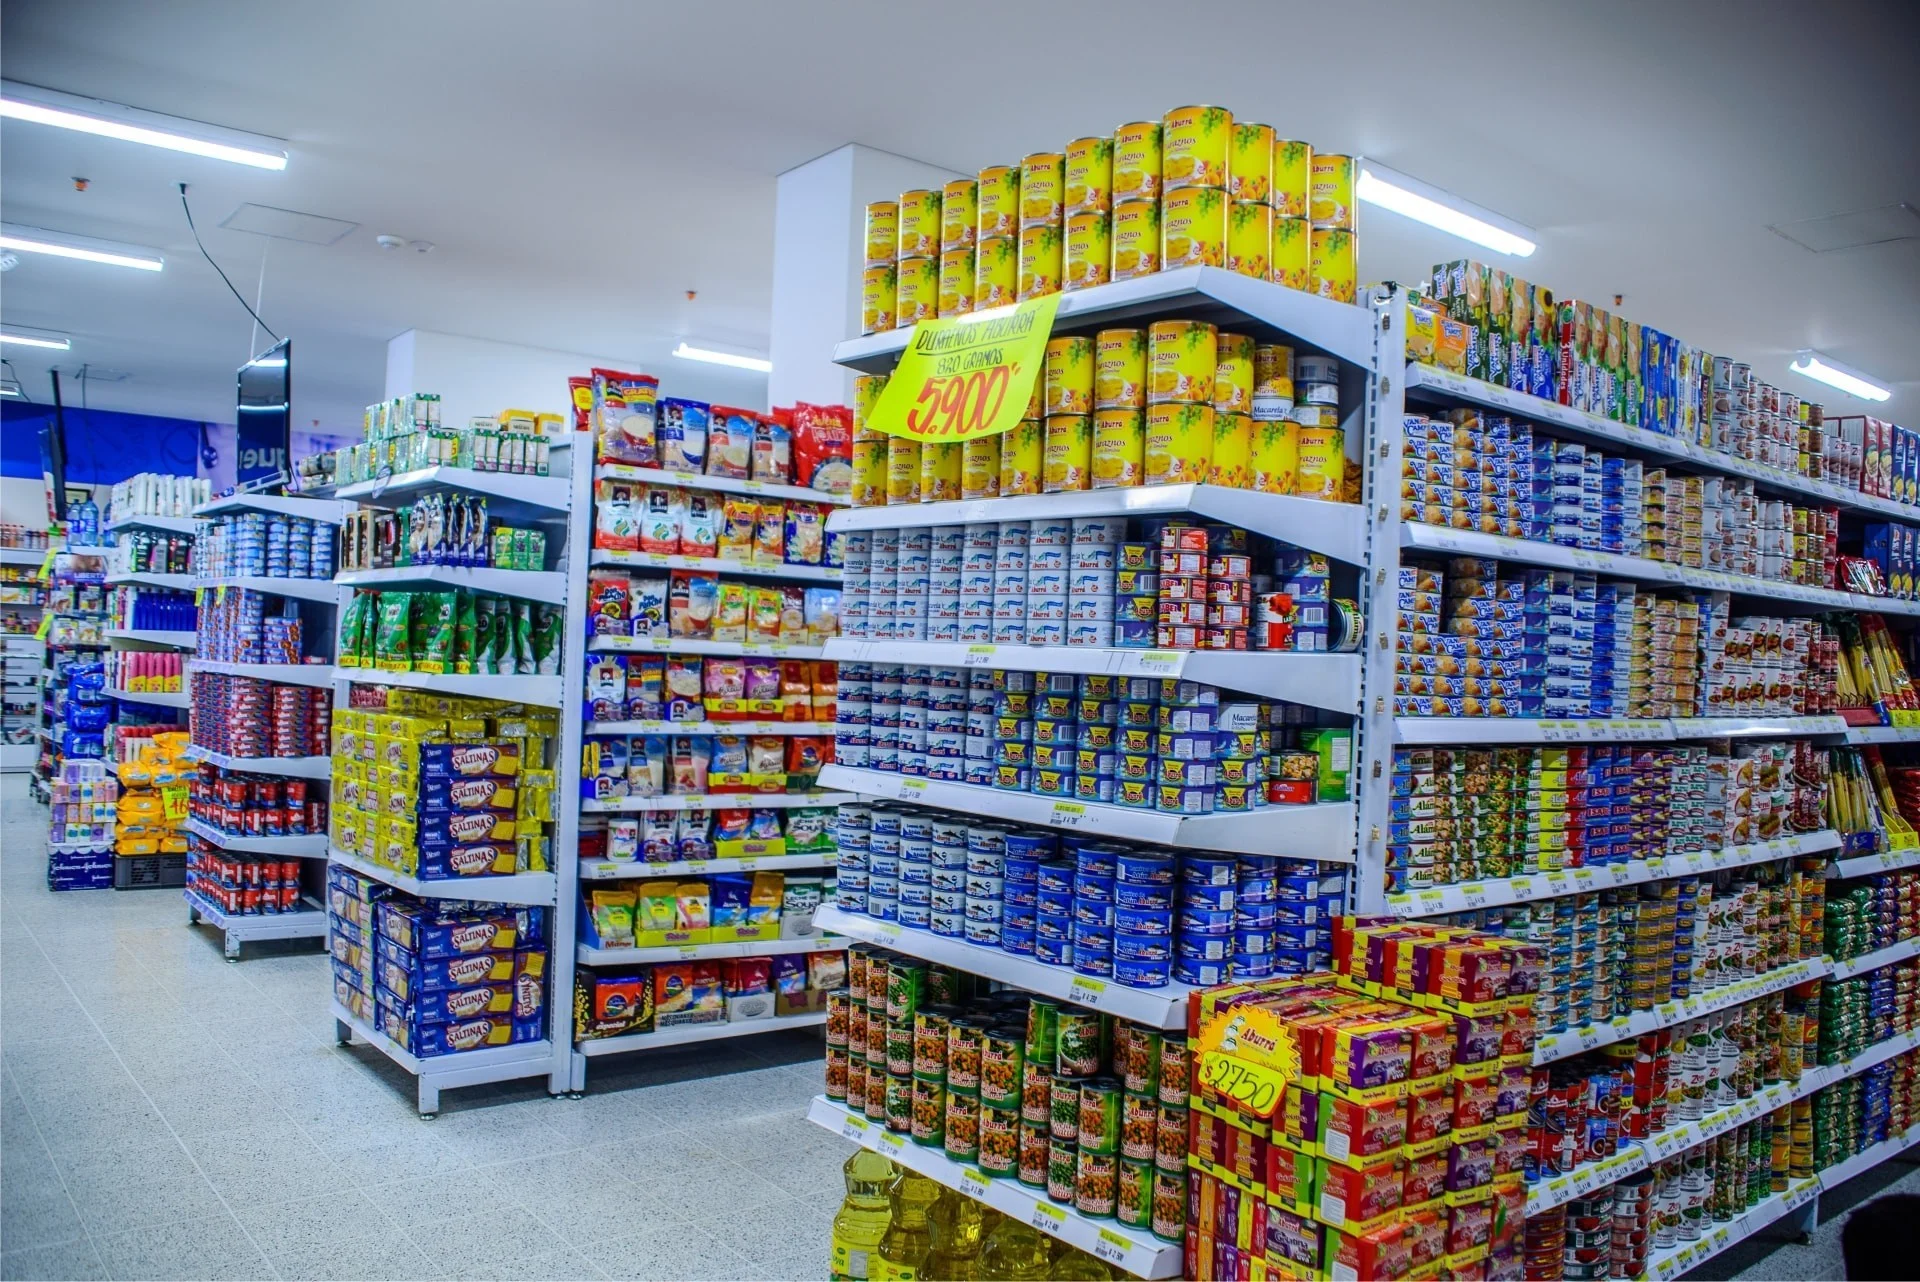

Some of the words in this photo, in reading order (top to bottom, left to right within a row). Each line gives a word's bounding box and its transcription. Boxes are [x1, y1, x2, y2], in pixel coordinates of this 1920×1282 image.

[1561, 342, 1570, 350] 3
[937, 355, 960, 375] 820
[963, 347, 1004, 370] GRAMOS
[1561, 351, 1569, 390] Unidades
[454, 751, 495, 770] SALTINAS
[453, 783, 493, 803] SALTINAS
[451, 817, 492, 836] SALTINAS
[452, 850, 493, 869] SALTINAS
[453, 924, 494, 949] SALTINAS
[450, 958, 490, 980] SALTINAS
[449, 990, 490, 1012] SALTINAS
[448, 1022, 488, 1046] SALTINAS
